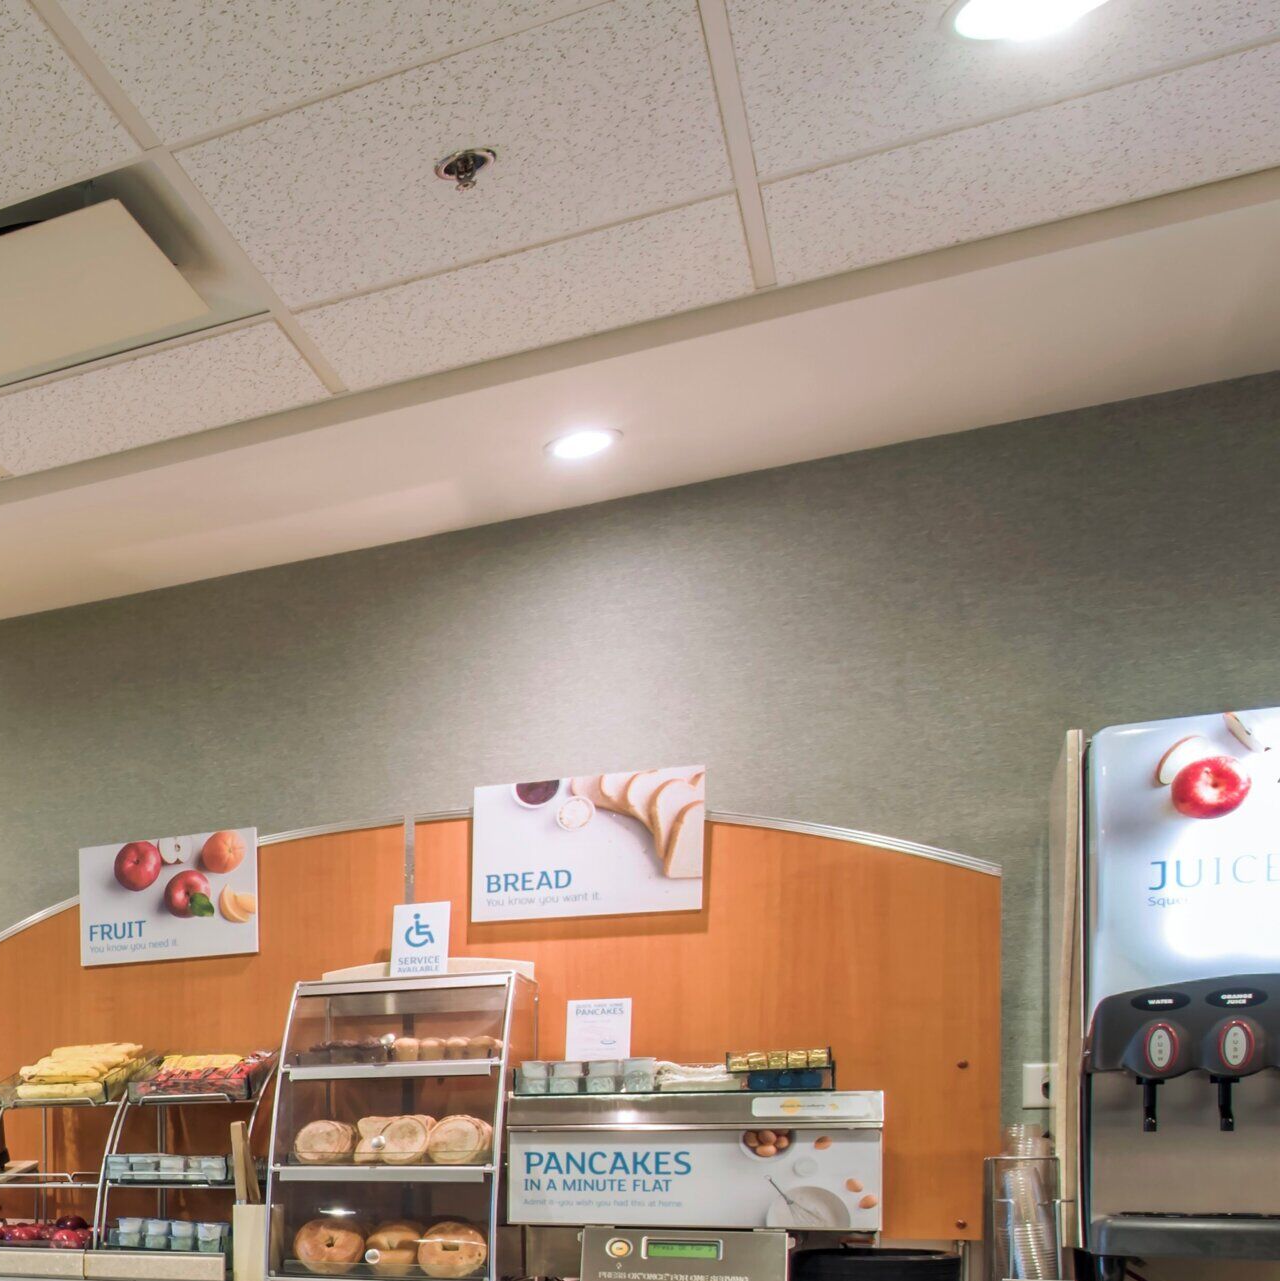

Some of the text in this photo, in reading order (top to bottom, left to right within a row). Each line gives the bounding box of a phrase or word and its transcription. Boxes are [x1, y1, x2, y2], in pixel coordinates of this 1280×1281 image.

[486, 869, 572, 893] BREAD
[486, 898, 505, 907] You
[508, 895, 535, 906] know
[540, 895, 559, 906] you
[563, 891, 588, 902] want
[89, 920, 146, 942] FRUIT
[89, 945, 104, 953] You
[107, 943, 128, 953] know
[130, 943, 146, 953] you
[149, 938, 169, 948] need
[398, 955, 440, 966] SERVICE
[397, 964, 439, 973] AVAILABLE
[575, 1008, 624, 1016] PANCAKES
[524, 1151, 692, 1175] PANCAKES
[524, 1178, 672, 1192] IN A MINUTE FLAT
[596, 1200, 610, 1208] you
[631, 1199, 645, 1207] this
[598, 1271, 626, 1279] PRESS
[671, 1273, 689, 1281] FOR
[690, 1274, 709, 1281] ONE
